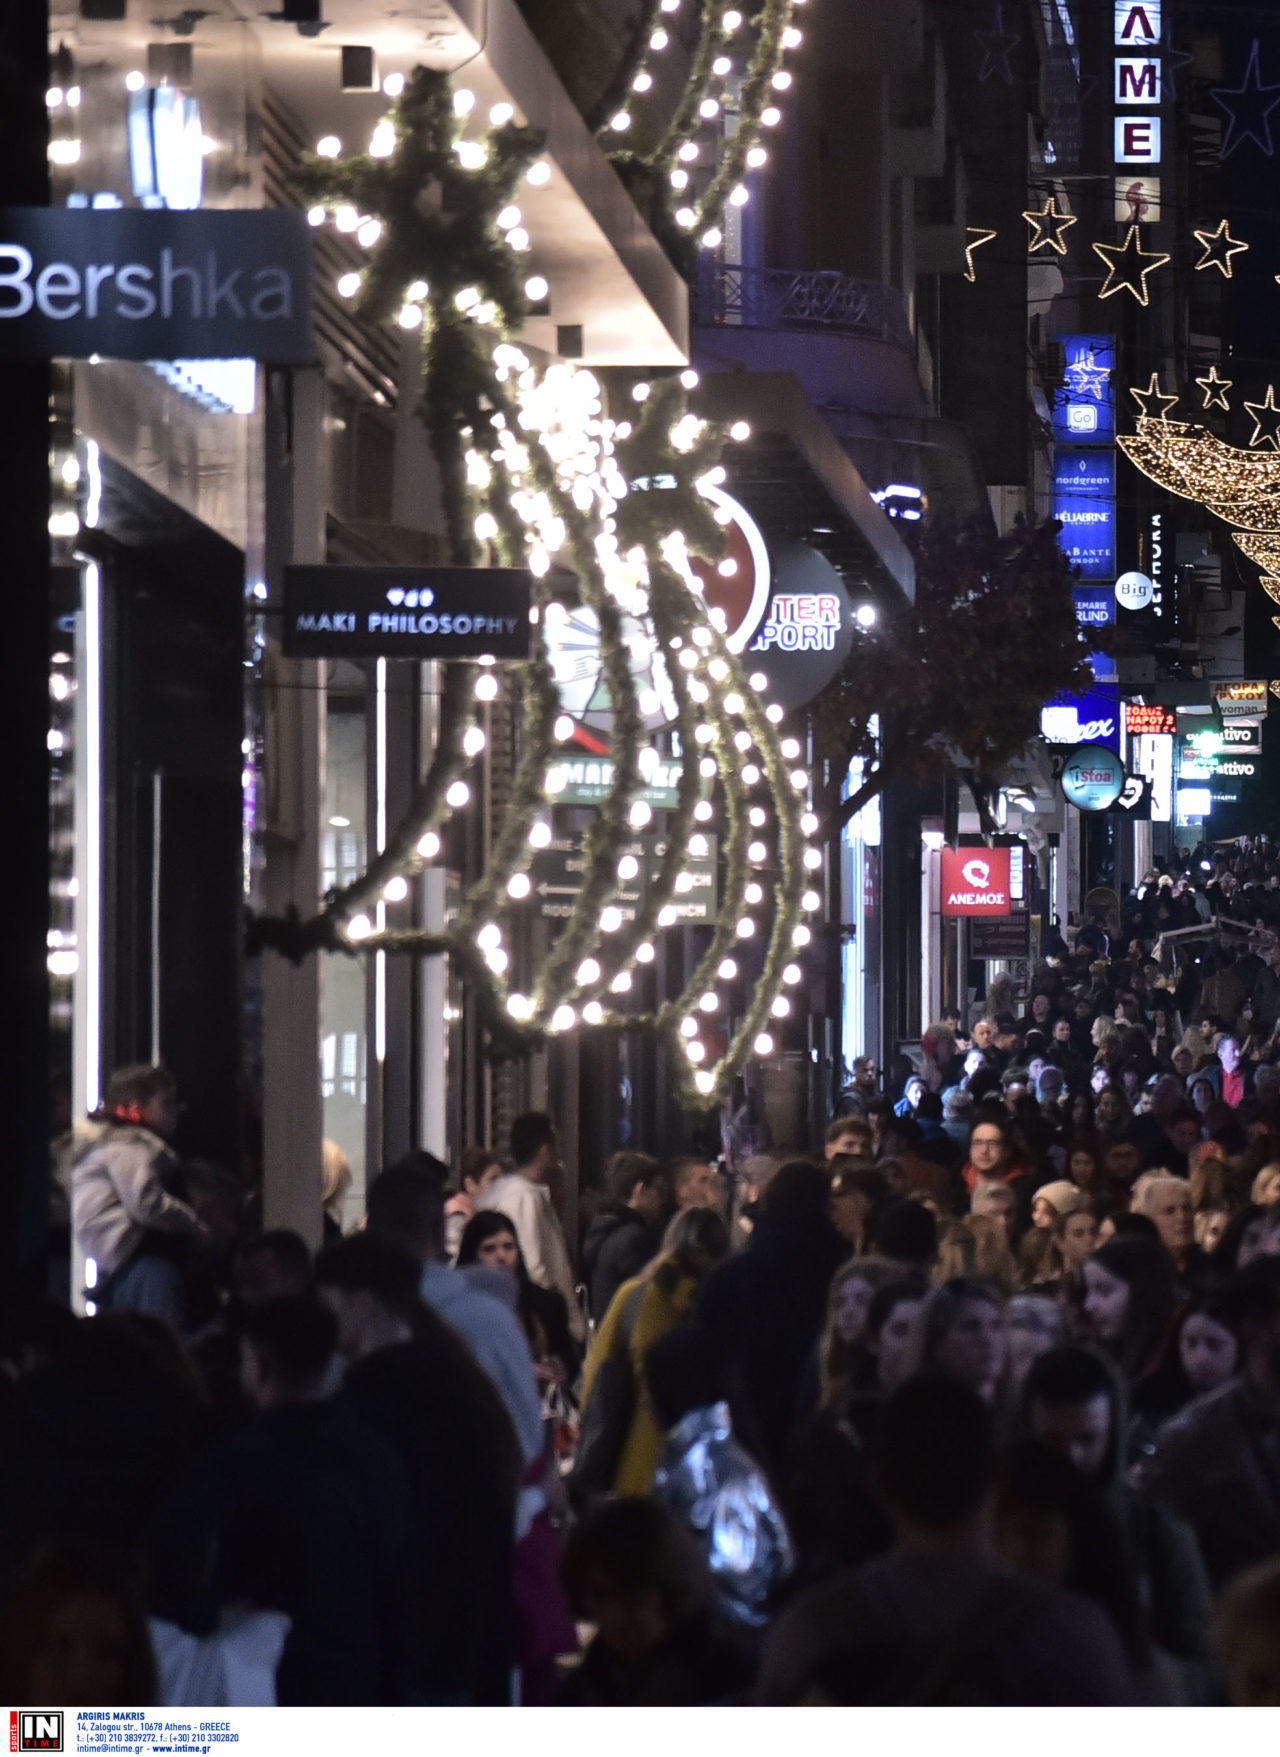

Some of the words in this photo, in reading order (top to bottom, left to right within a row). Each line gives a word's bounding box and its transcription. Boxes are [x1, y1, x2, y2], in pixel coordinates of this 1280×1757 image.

[0, 243, 292, 319] Bershka
[1056, 476, 1110, 486] nordgreen
[769, 595, 840, 622] TER
[296, 612, 357, 632] MAKI
[367, 612, 519, 634] PHILOSOPHY
[948, 893, 1006, 905] ΑΝΕΜΟΣ
